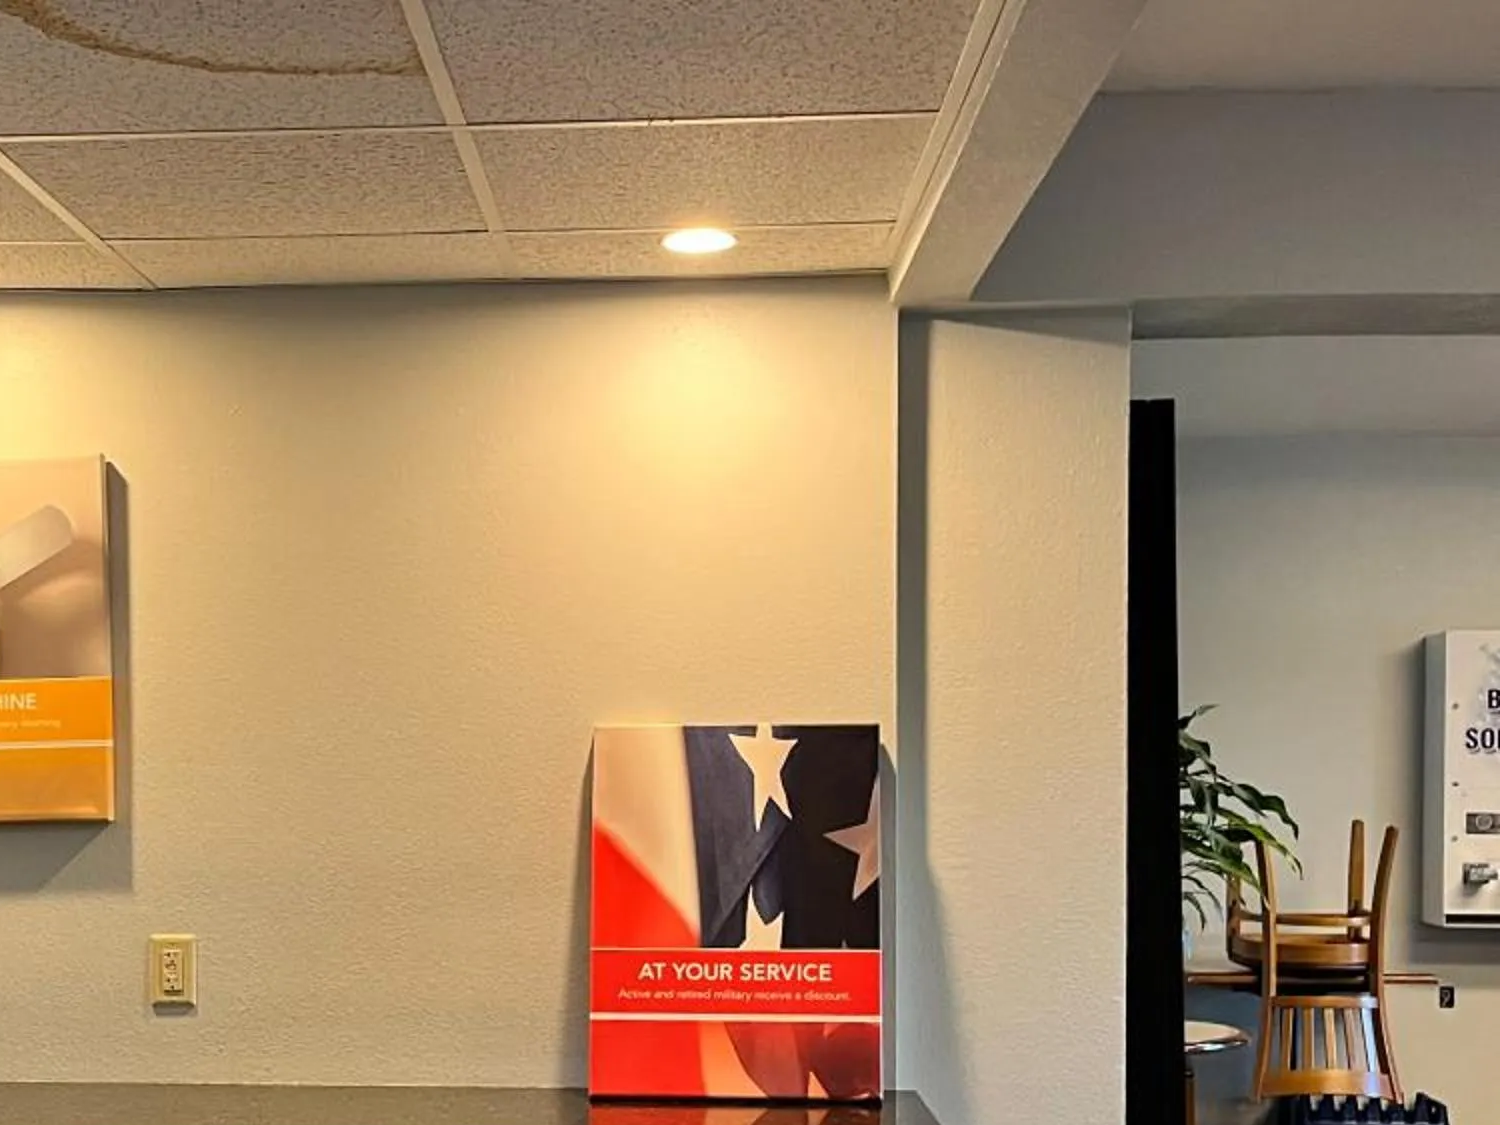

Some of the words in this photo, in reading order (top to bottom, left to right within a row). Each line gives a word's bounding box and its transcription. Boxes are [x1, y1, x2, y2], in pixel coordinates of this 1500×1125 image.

[1466, 727, 1500, 750] SO
[637, 962, 666, 981] AT
[672, 962, 733, 982] YOUR
[739, 963, 833, 983] SERVICE
[618, 987, 651, 999] Active
[653, 988, 675, 999] and
[676, 988, 711, 1000] retired
[713, 988, 752, 1003] military
[754, 990, 793, 1001] receive
[795, 991, 801, 1000] a
